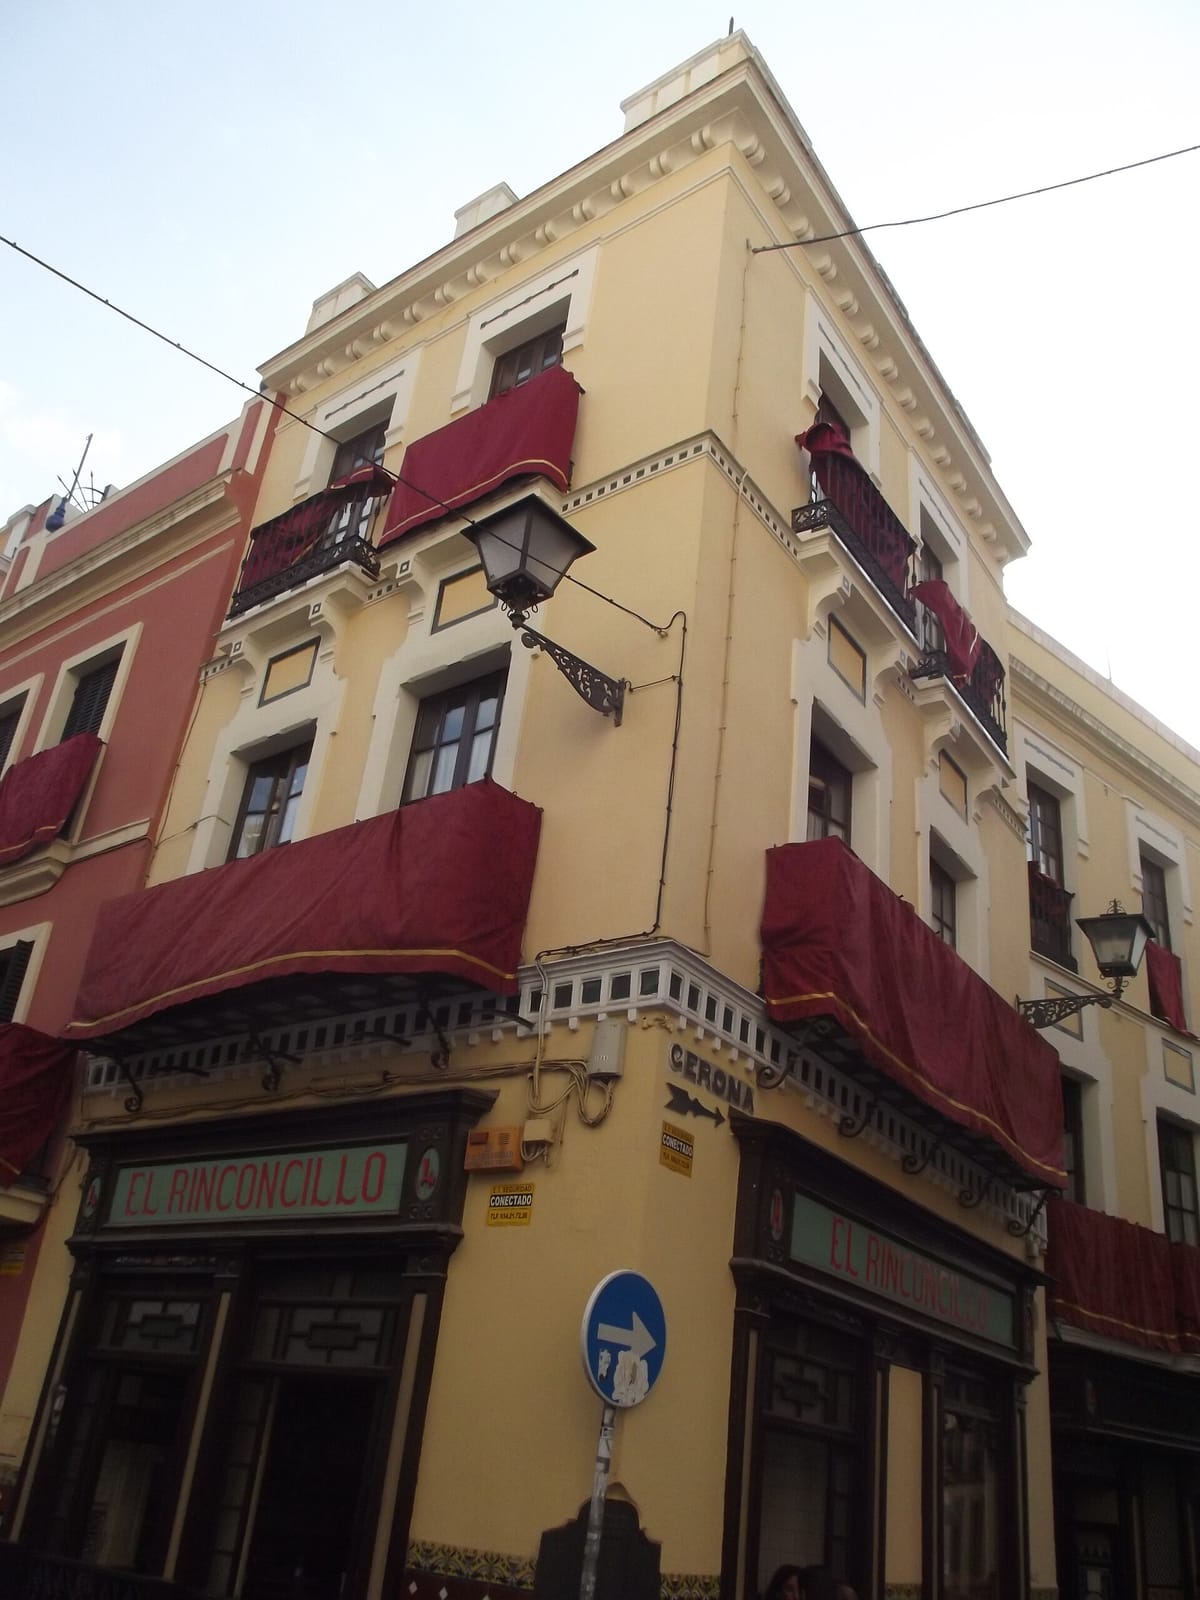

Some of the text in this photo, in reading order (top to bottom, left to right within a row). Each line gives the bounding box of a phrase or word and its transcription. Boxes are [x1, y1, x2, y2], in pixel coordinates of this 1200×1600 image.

[669, 1042, 754, 1116] GERONA
[663, 1134, 692, 1157] CONECTADO
[125, 1151, 388, 1216] EL RINCONCILLO
[491, 1194, 532, 1207] CONECTADO
[830, 1215, 988, 1332] EL RINCONCILLO
